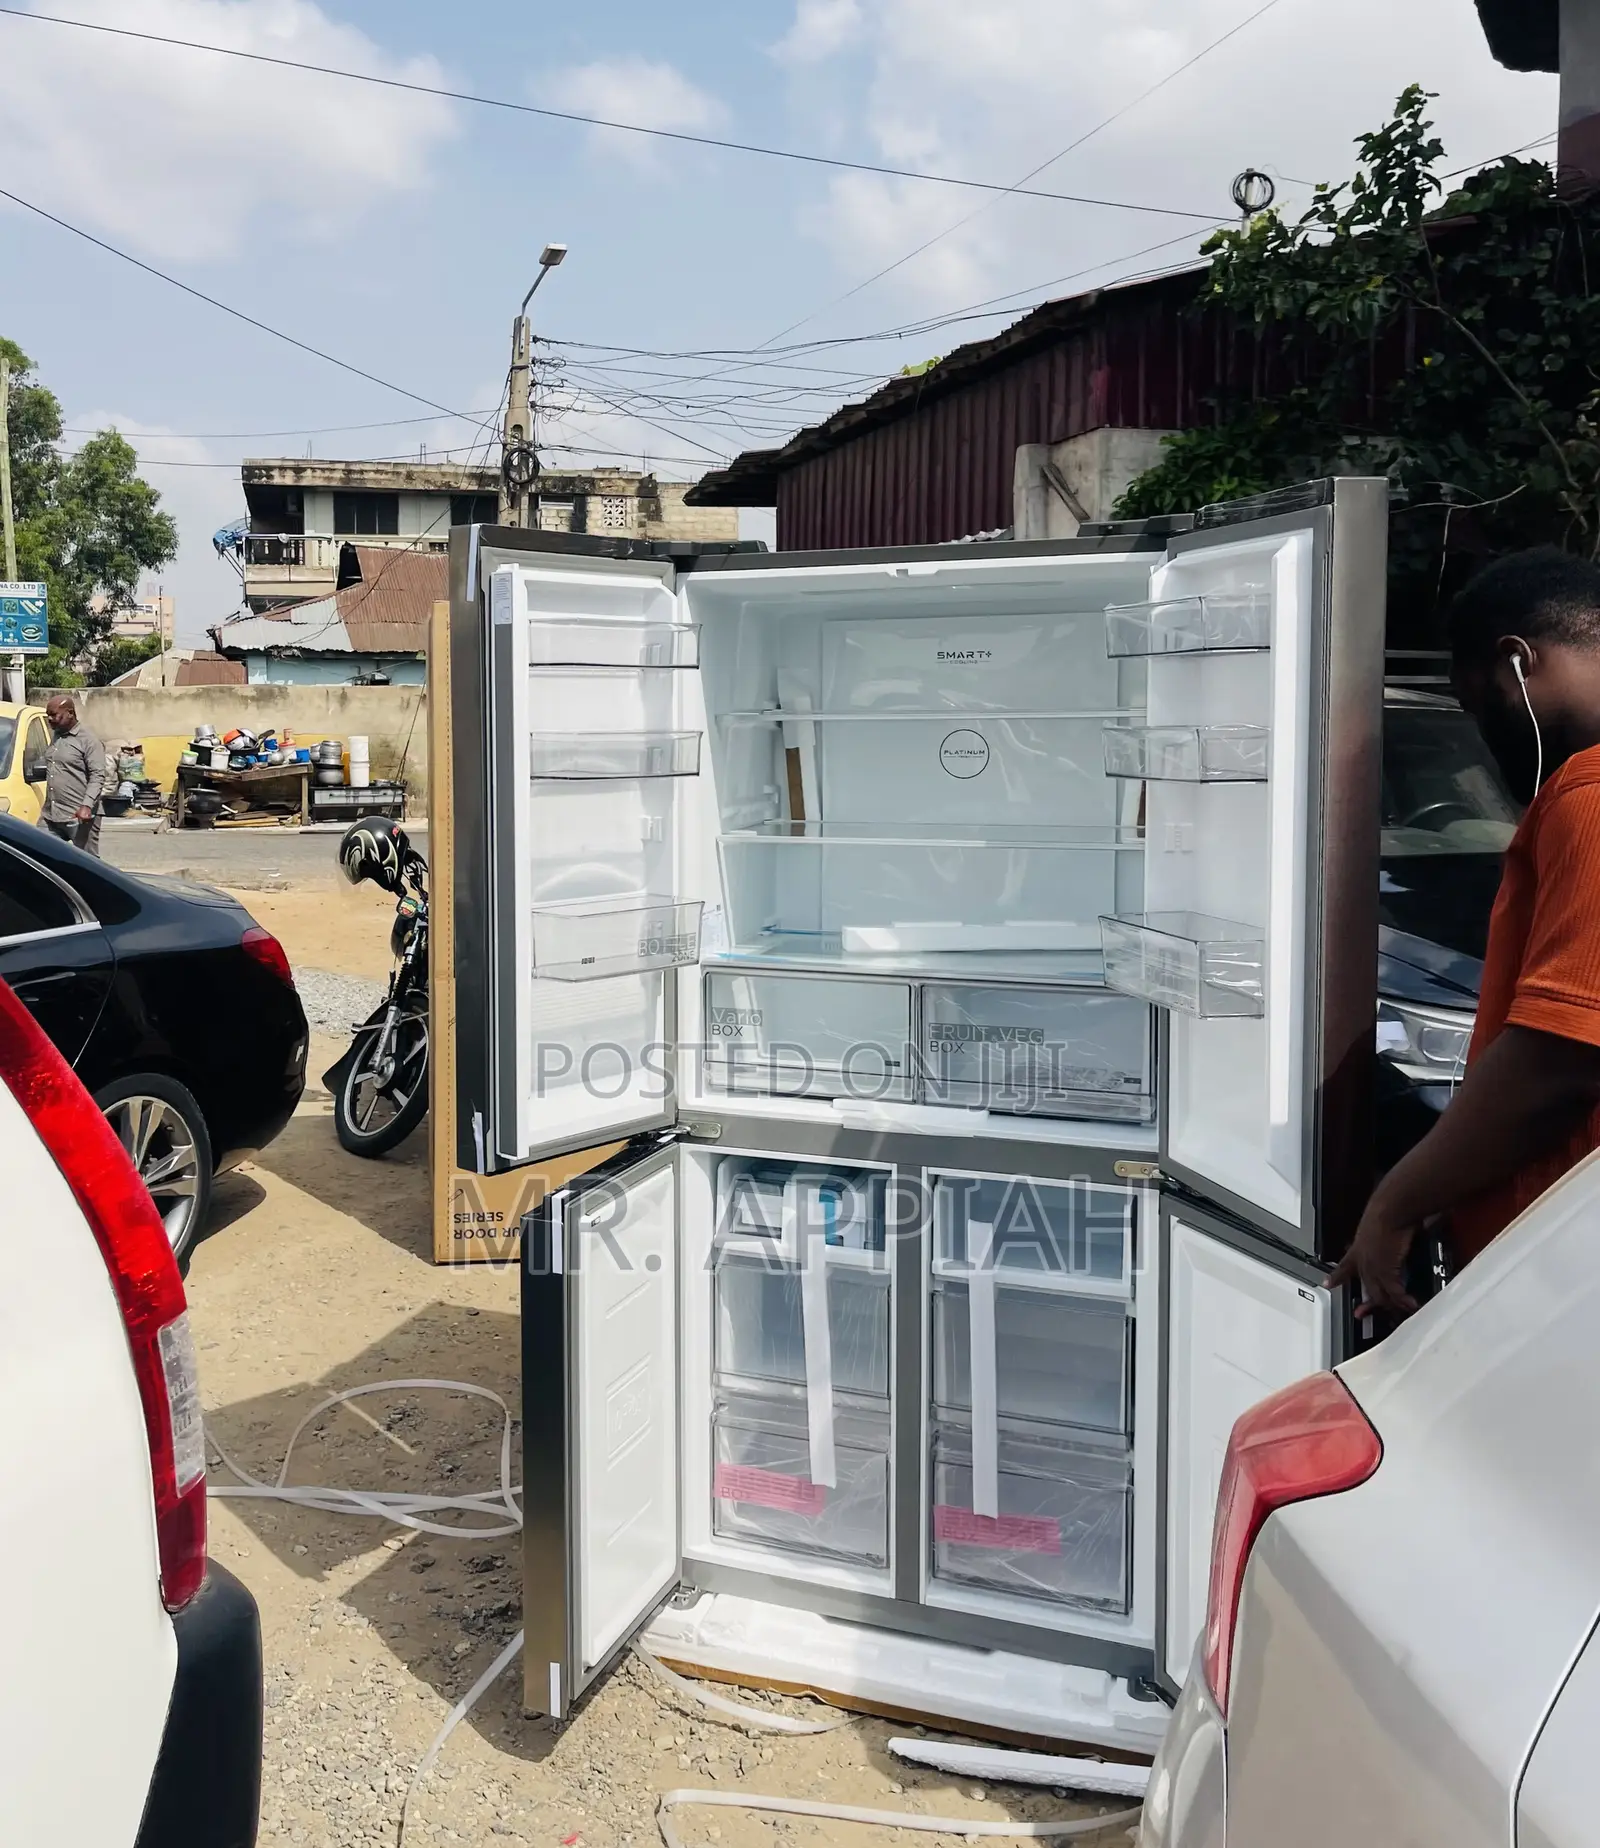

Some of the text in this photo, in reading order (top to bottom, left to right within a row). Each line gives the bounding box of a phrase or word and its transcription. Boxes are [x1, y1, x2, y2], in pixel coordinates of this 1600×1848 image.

[712, 1008, 762, 1026] Vario
[711, 1024, 744, 1037] BOX
[929, 1024, 989, 1041] FRUIT
[999, 1028, 1044, 1044] VEG
[929, 1040, 965, 1054] BOX
[453, 1211, 504, 1224] SERIES
[453, 1228, 497, 1240] DOOR
